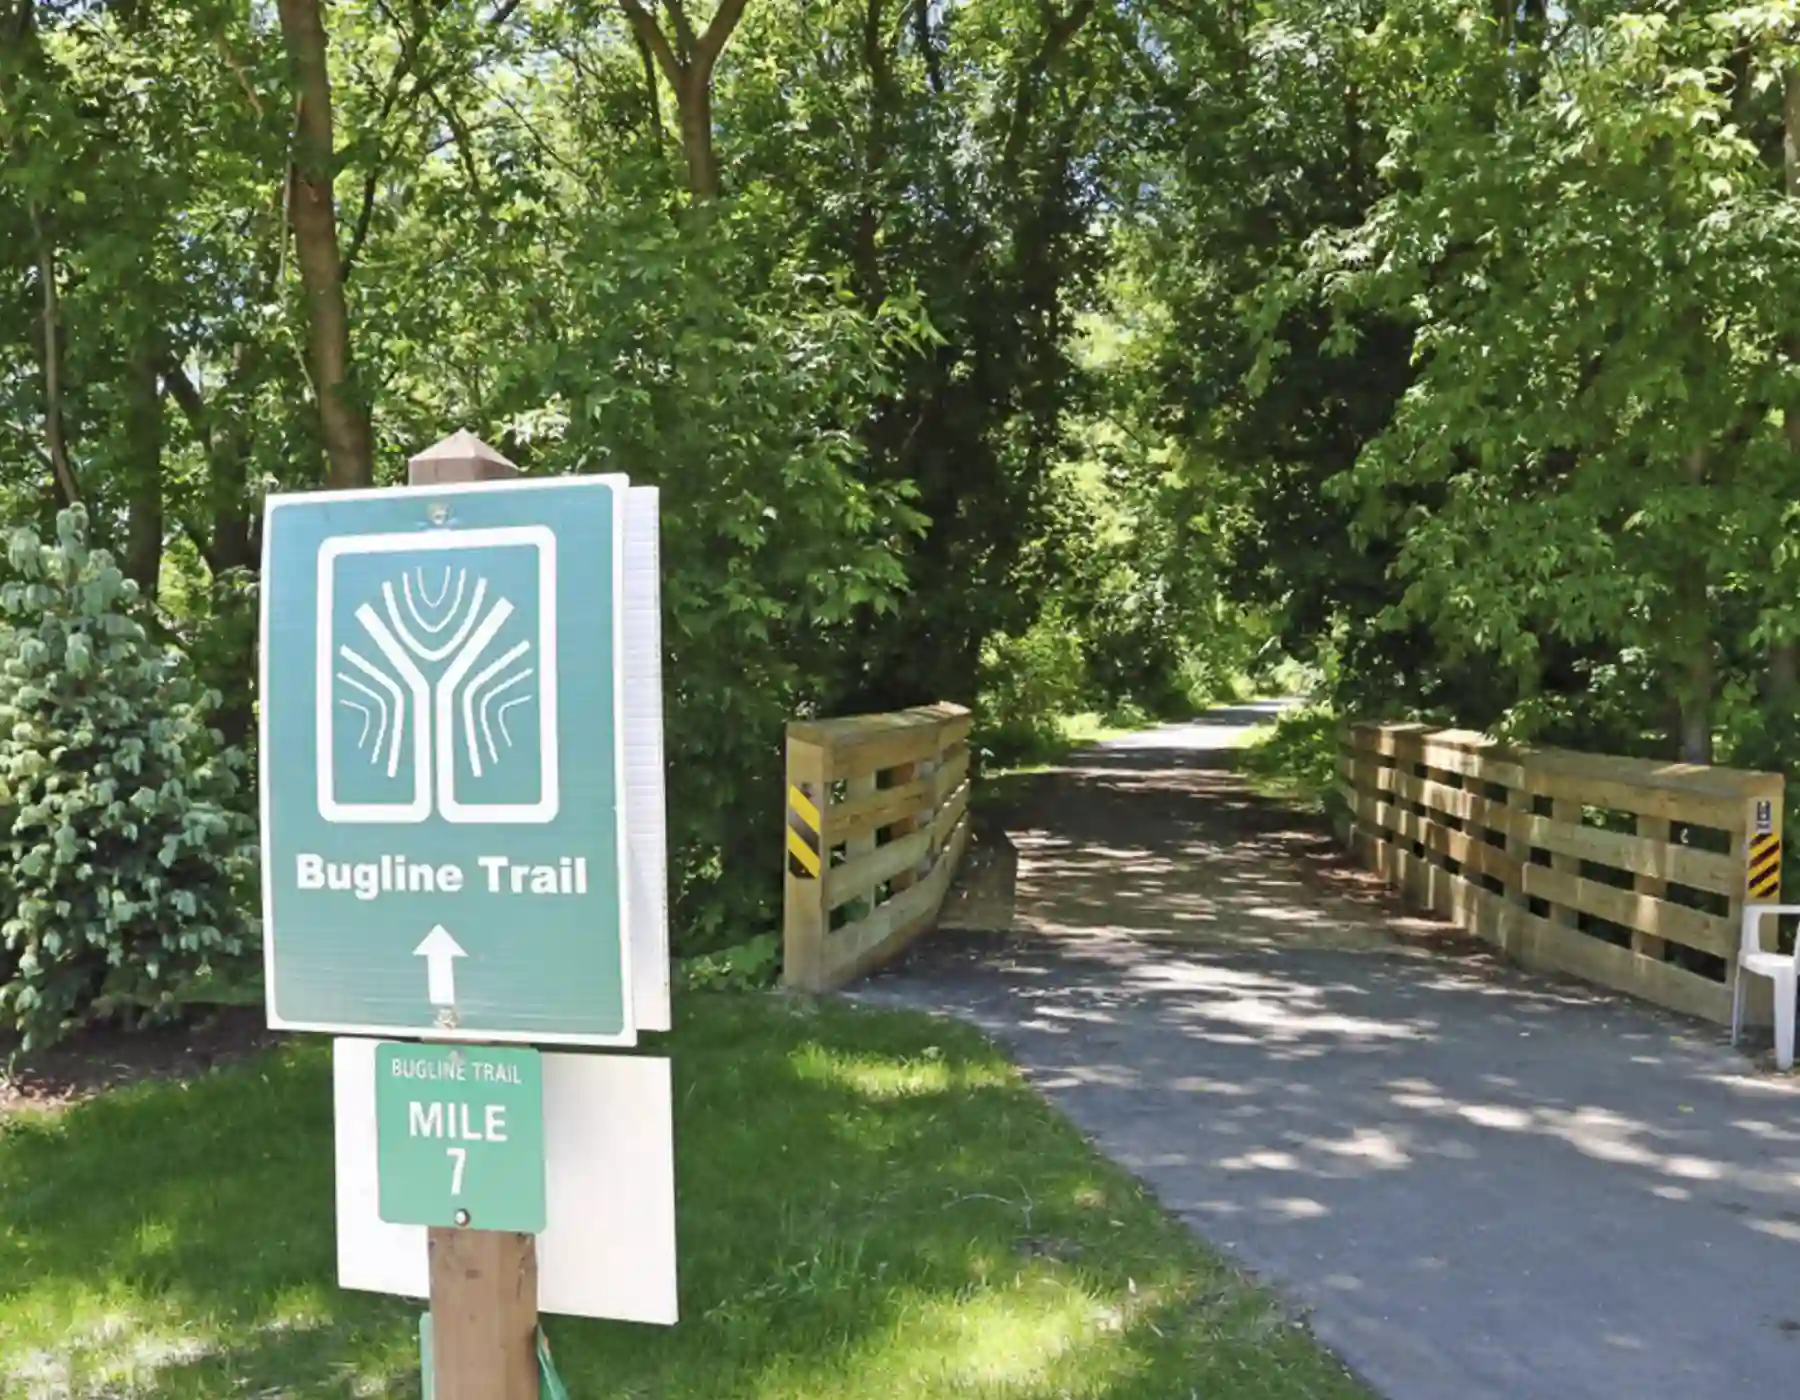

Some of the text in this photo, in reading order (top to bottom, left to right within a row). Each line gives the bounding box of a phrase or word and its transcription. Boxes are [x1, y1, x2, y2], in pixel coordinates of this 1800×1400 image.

[296, 853, 588, 901] Bugline Trail
[391, 1058, 522, 1085] BUGLINE TRAIL
[408, 1101, 508, 1142] MILE
[446, 1148, 466, 1196] 7
